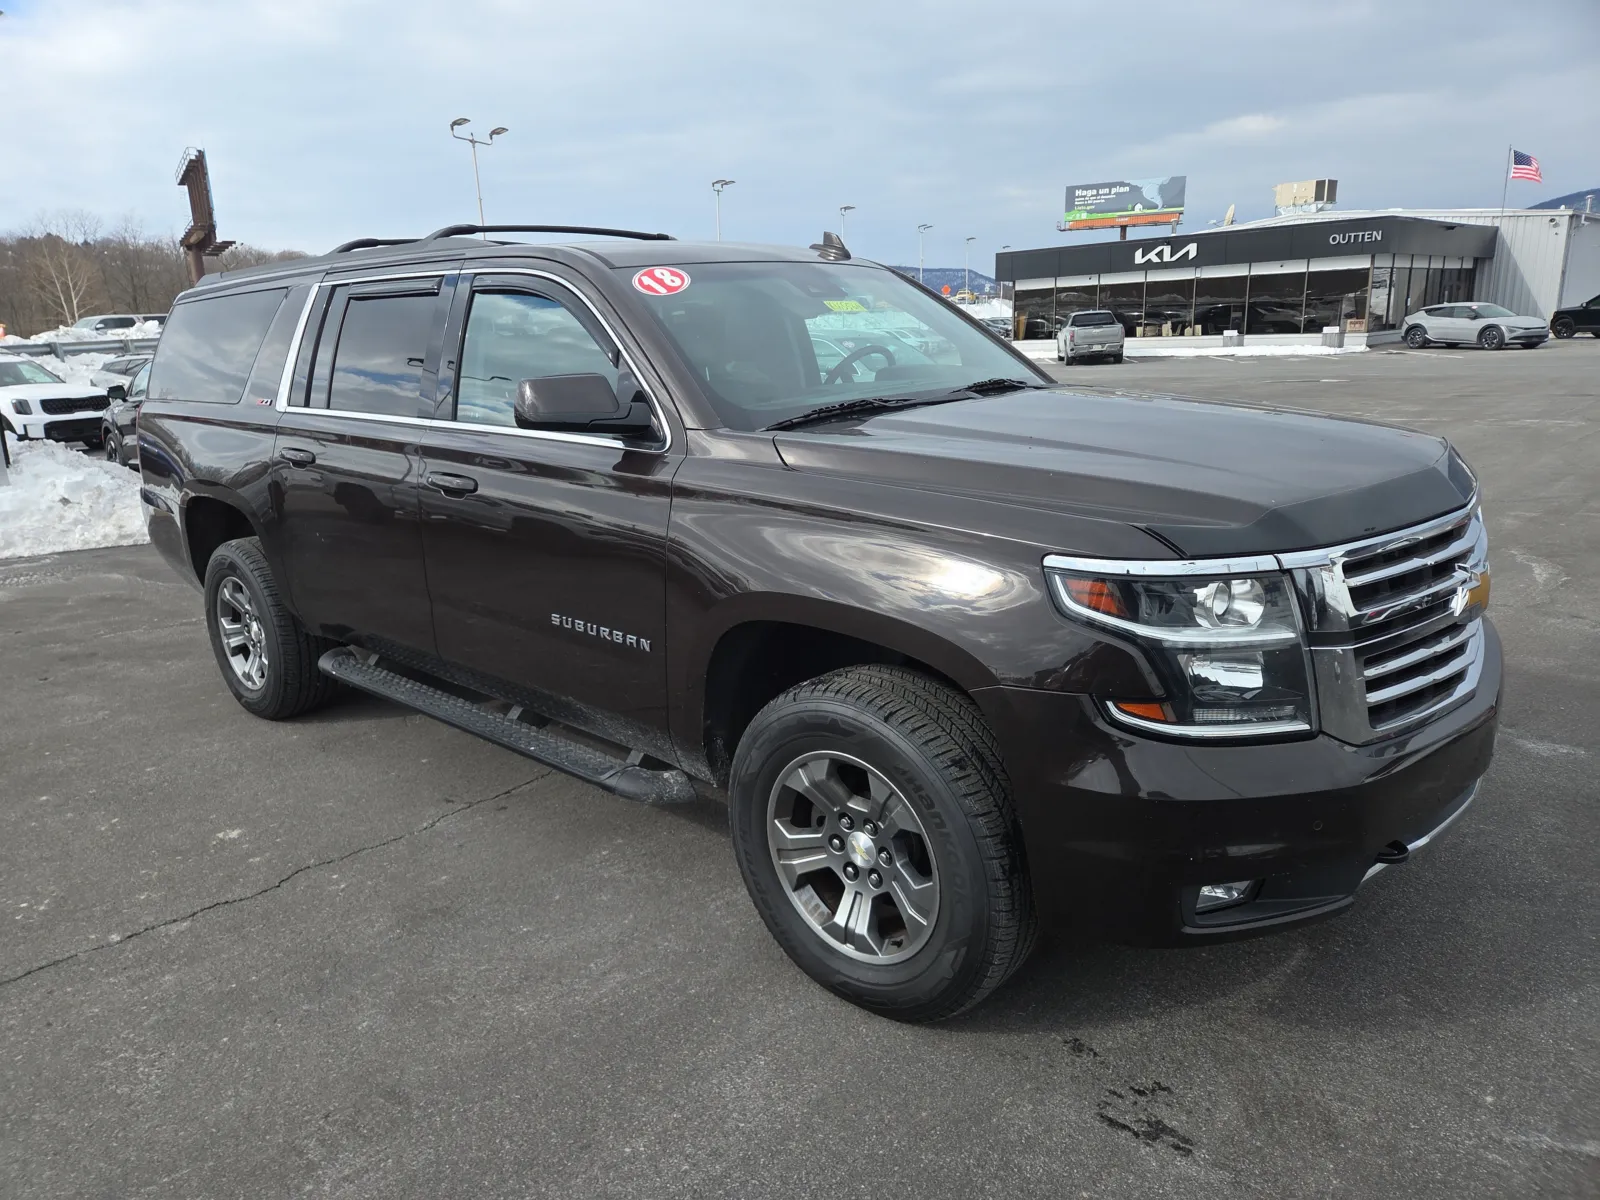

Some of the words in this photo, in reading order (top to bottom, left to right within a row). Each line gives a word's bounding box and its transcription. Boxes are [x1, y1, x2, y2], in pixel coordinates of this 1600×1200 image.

[1075, 189, 1097, 197] Haga
[1111, 185, 1130, 194] plan
[1328, 230, 1383, 245] OUTTEN
[1134, 242, 1198, 265] KIA
[640, 269, 682, 294] 18
[550, 613, 652, 653] SUBURBAN
